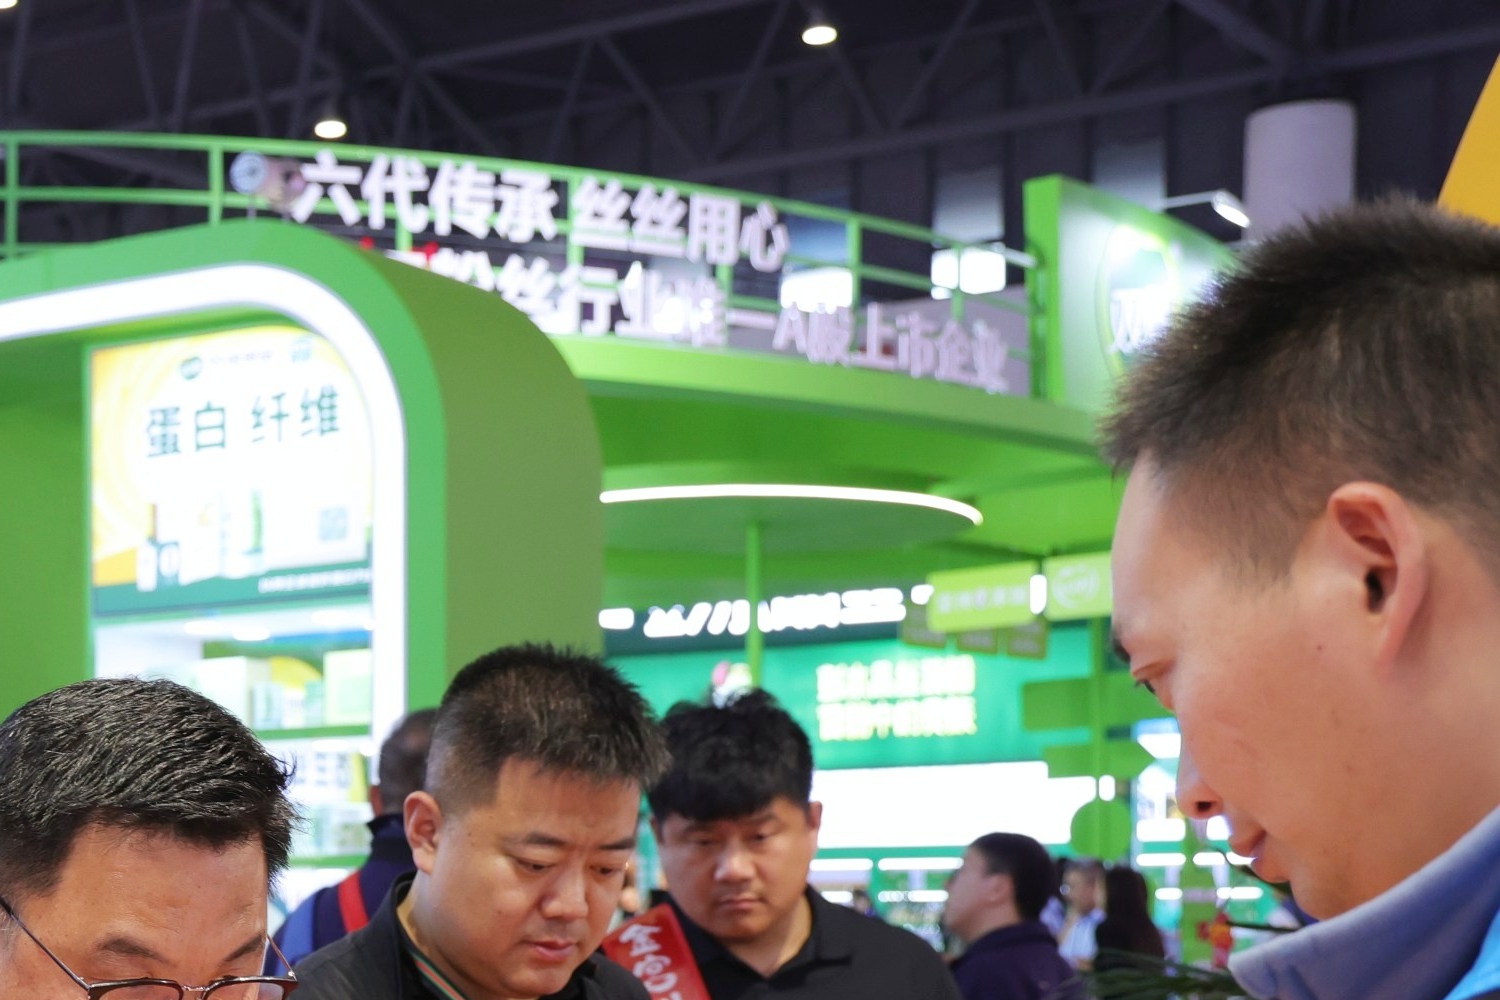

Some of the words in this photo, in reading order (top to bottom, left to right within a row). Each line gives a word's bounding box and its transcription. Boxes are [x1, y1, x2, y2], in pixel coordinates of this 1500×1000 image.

[293, 149, 558, 243] 六代传承
[571, 176, 790, 274] 丝丝用心
[147, 400, 227, 459] 蛋白
[250, 384, 341, 443] 纤维
